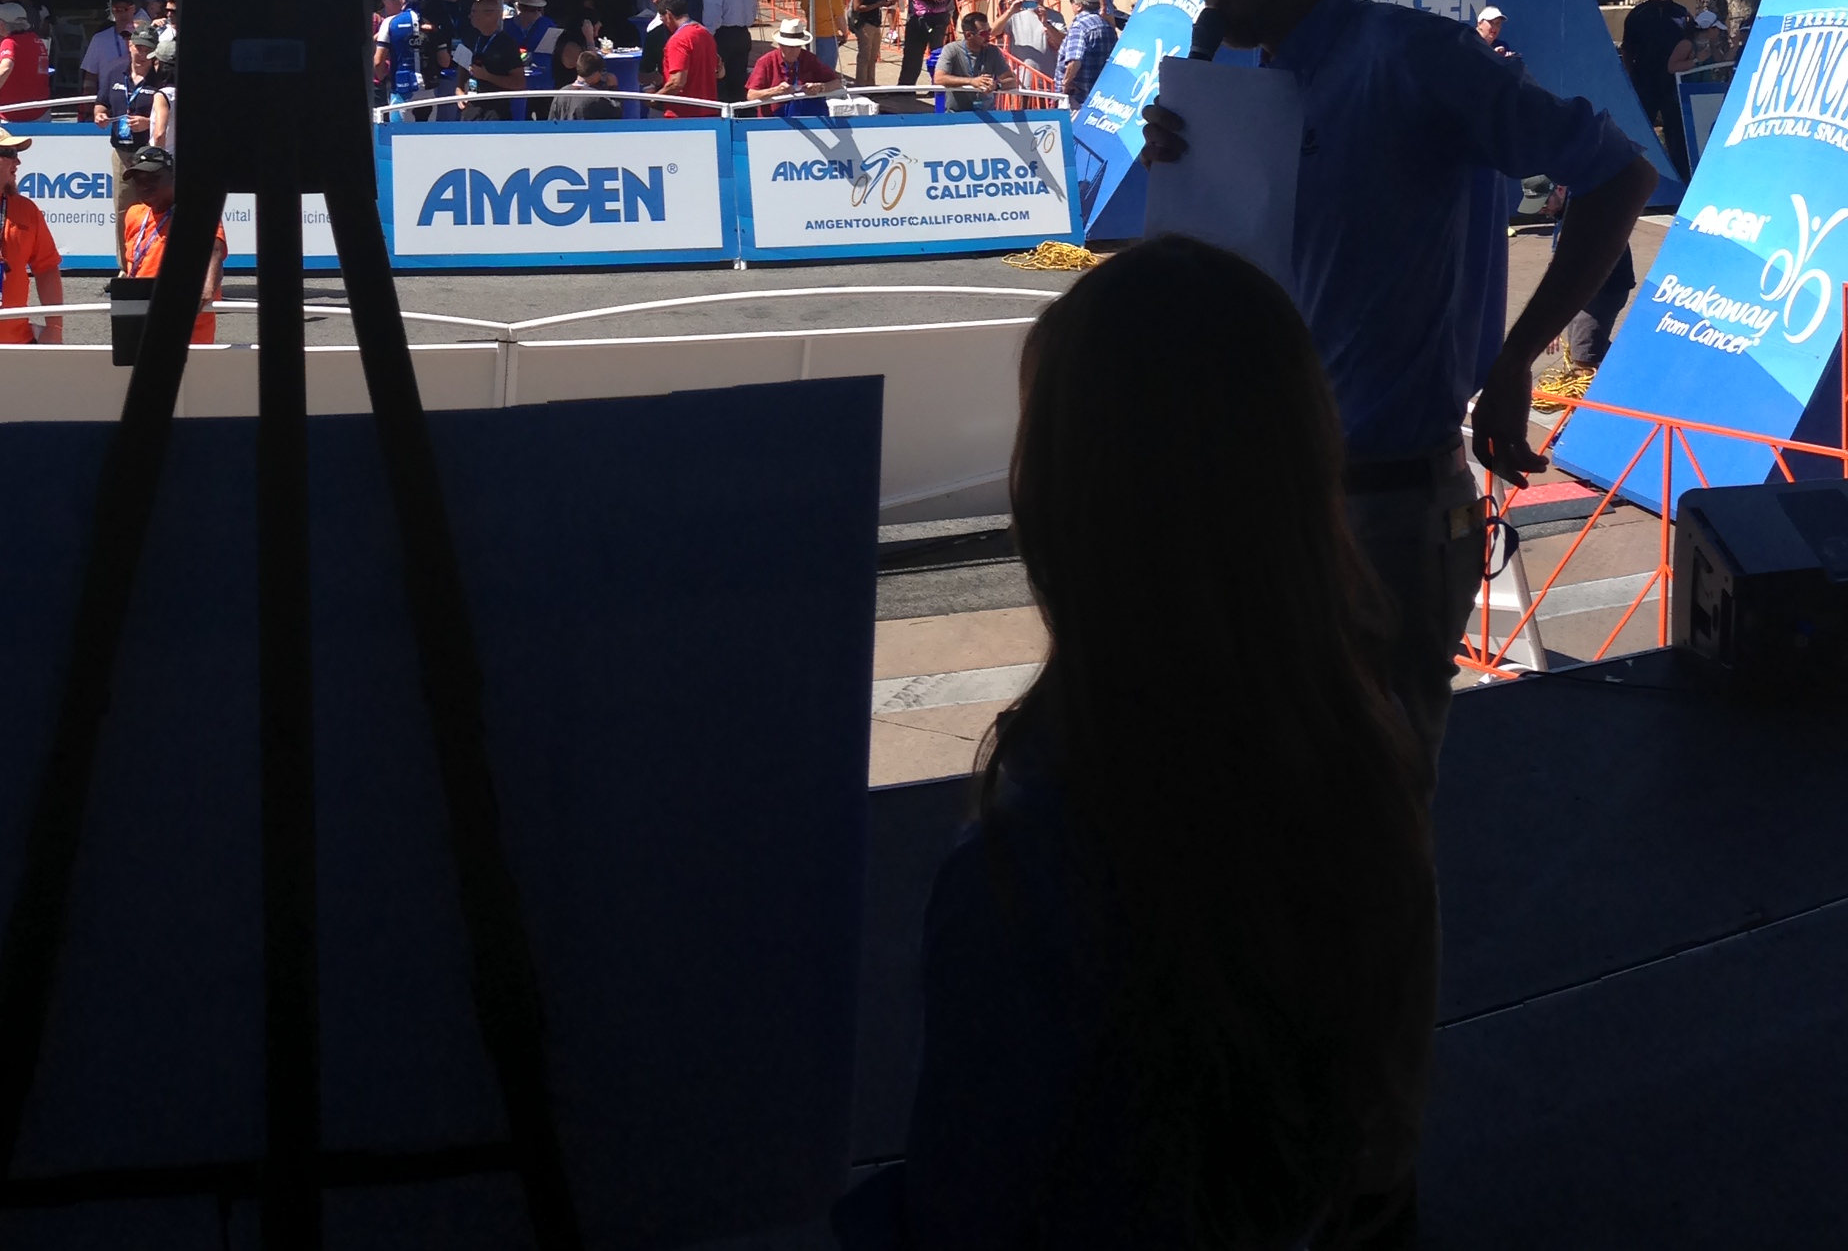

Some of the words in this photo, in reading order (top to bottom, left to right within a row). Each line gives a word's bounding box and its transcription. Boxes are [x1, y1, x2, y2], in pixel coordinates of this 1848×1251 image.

[1743, 119, 1813, 140] NATURAL
[772, 159, 854, 182] AMGEN
[924, 158, 1011, 183] TOUR
[1014, 161, 1039, 180] of
[417, 165, 665, 227] AMGEN
[925, 181, 1050, 201] CALIFORNIA
[224, 209, 251, 222] vital
[1689, 205, 1768, 243] AMGEN
[1652, 274, 1779, 339] Breakaway
[1655, 311, 1691, 337] from
[1689, 319, 1757, 357] Cancer
